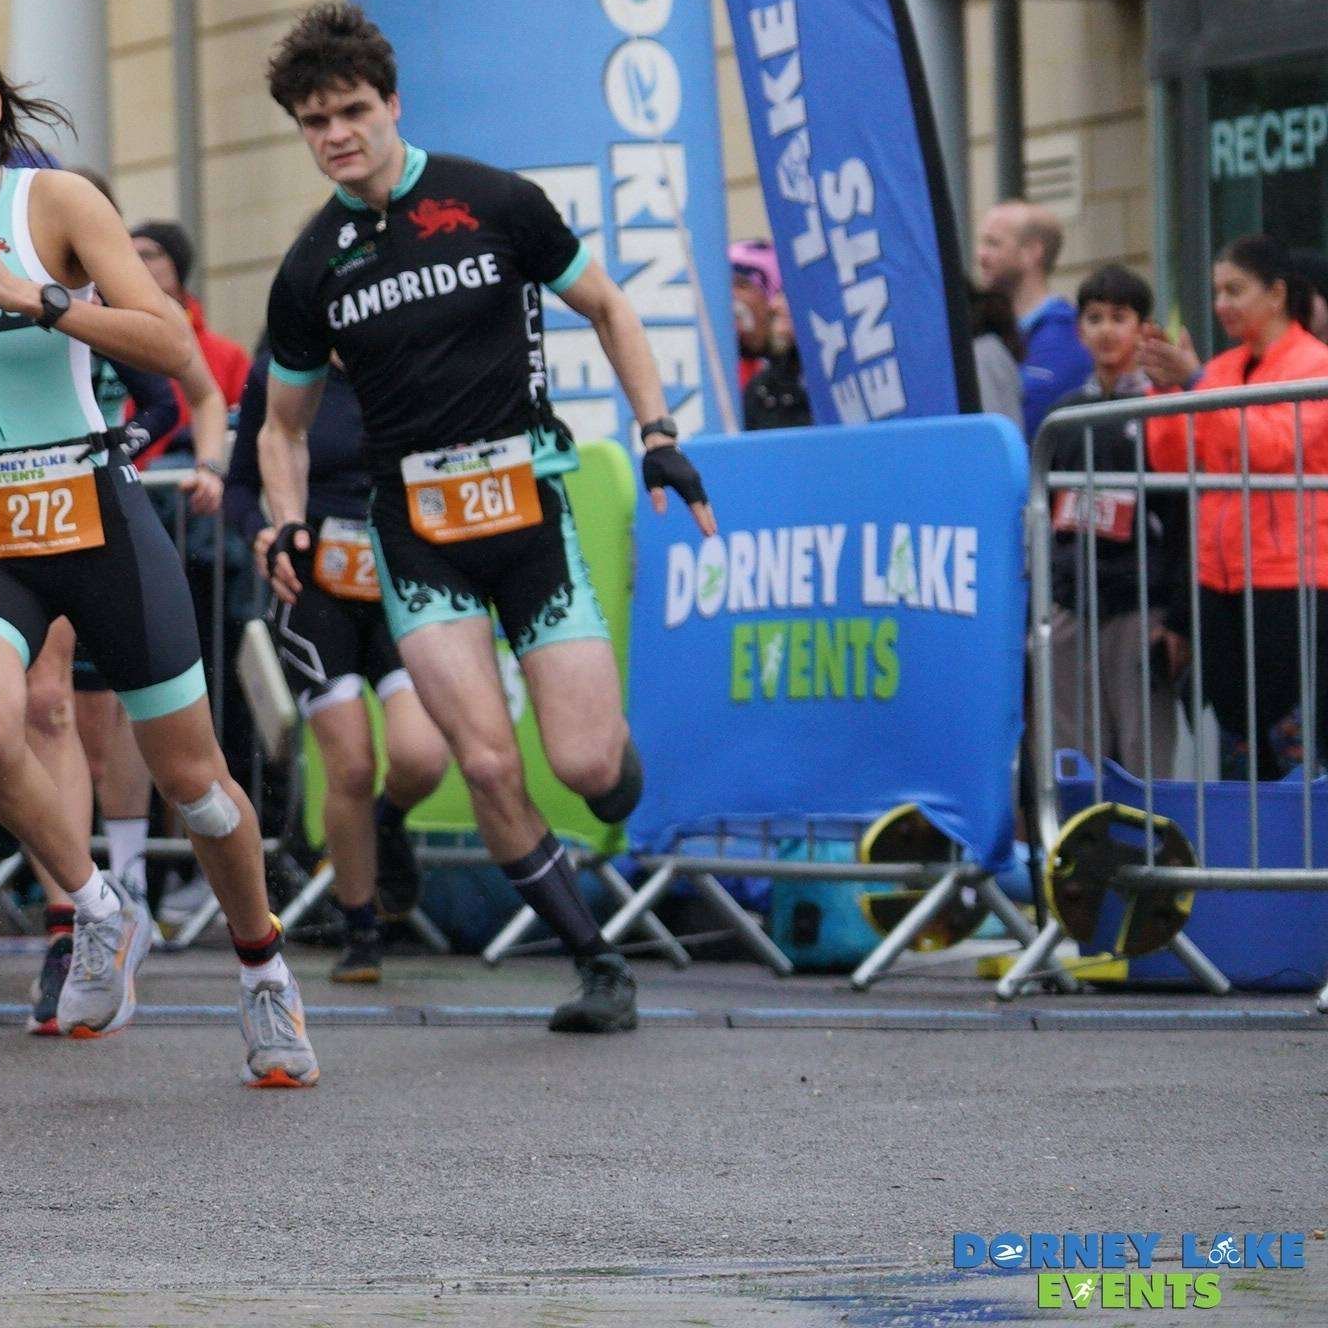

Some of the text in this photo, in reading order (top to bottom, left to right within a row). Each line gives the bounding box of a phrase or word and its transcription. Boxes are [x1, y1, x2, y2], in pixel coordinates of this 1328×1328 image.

[328, 253, 501, 330] CAMBRIDGE
[821, 157, 907, 421] ENTS
[33, 453, 67, 467] LAKE
[459, 474, 516, 523] 261
[7, 487, 77, 538] 272
[665, 522, 978, 629] DORNEY LAKE
[730, 617, 901, 703] EVENTS
